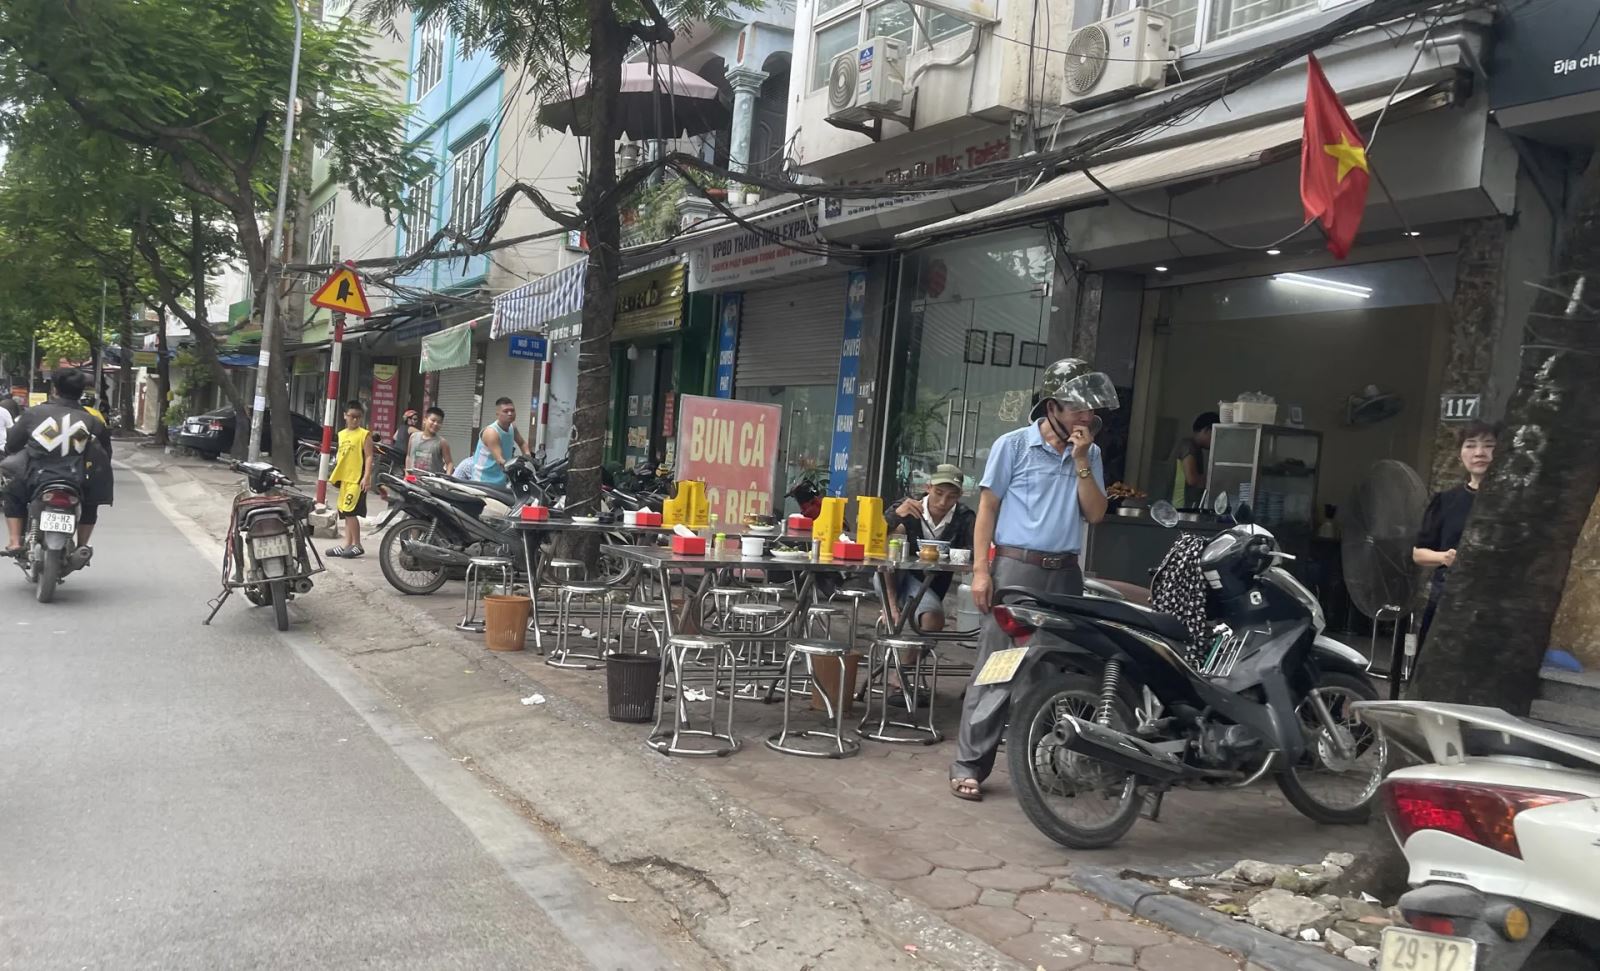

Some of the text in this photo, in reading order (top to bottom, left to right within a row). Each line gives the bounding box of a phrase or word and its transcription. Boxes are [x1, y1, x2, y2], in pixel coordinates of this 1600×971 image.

[1554, 59, 1577, 75] Địa
[842, 372, 856, 395] PHÁT
[1446, 398, 1476, 417] 117
[690, 408, 735, 465] BÚN
[739, 413, 765, 468] CÁ
